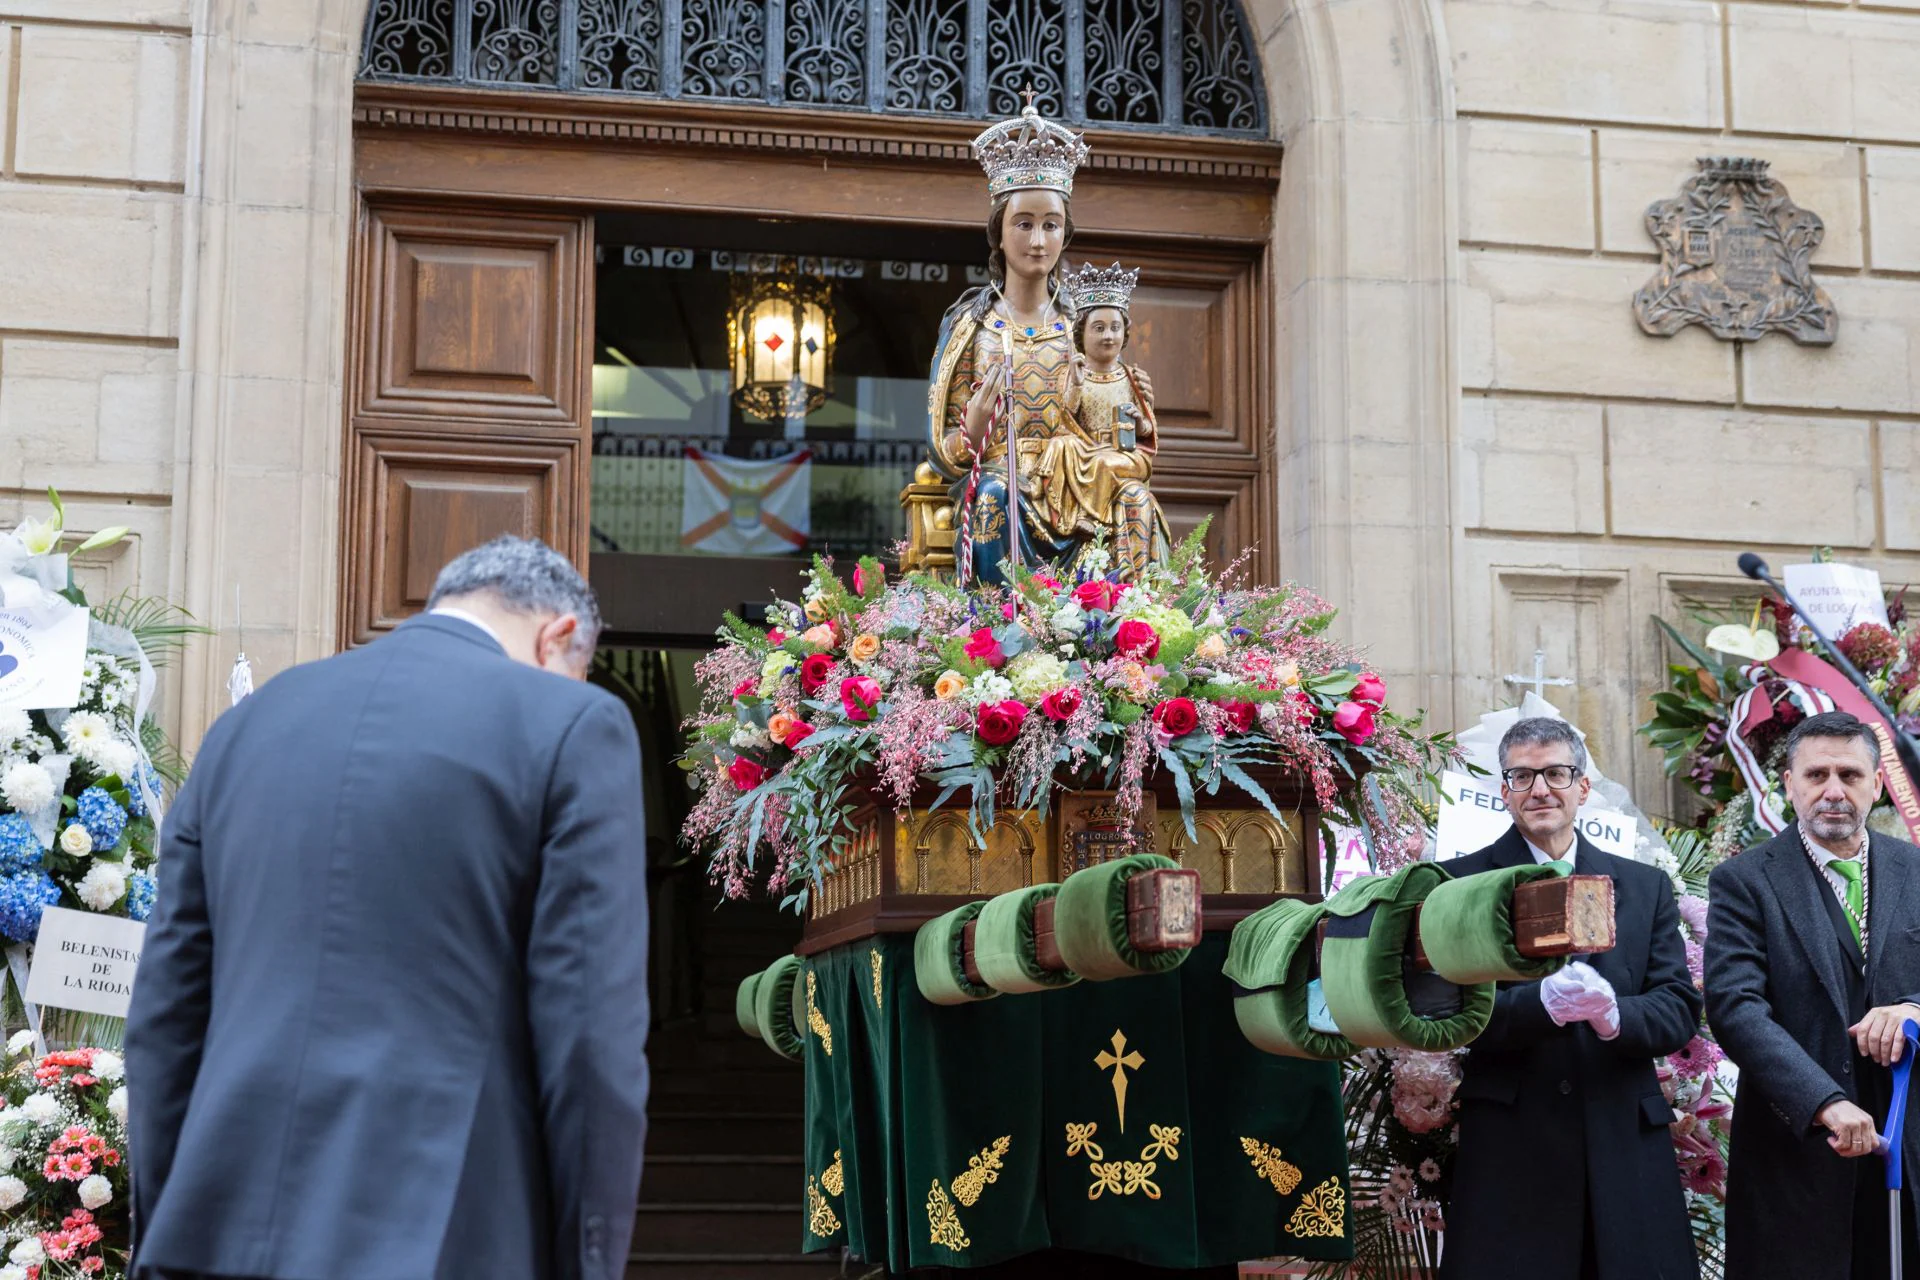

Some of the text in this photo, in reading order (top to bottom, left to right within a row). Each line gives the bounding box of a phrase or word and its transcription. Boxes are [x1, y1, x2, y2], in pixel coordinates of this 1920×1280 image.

[1809, 603, 1824, 614] DE
[1089, 832, 1136, 841] LOGRO
[92, 963, 112, 976] DE
[64, 976, 131, 996] LA RIOJA
